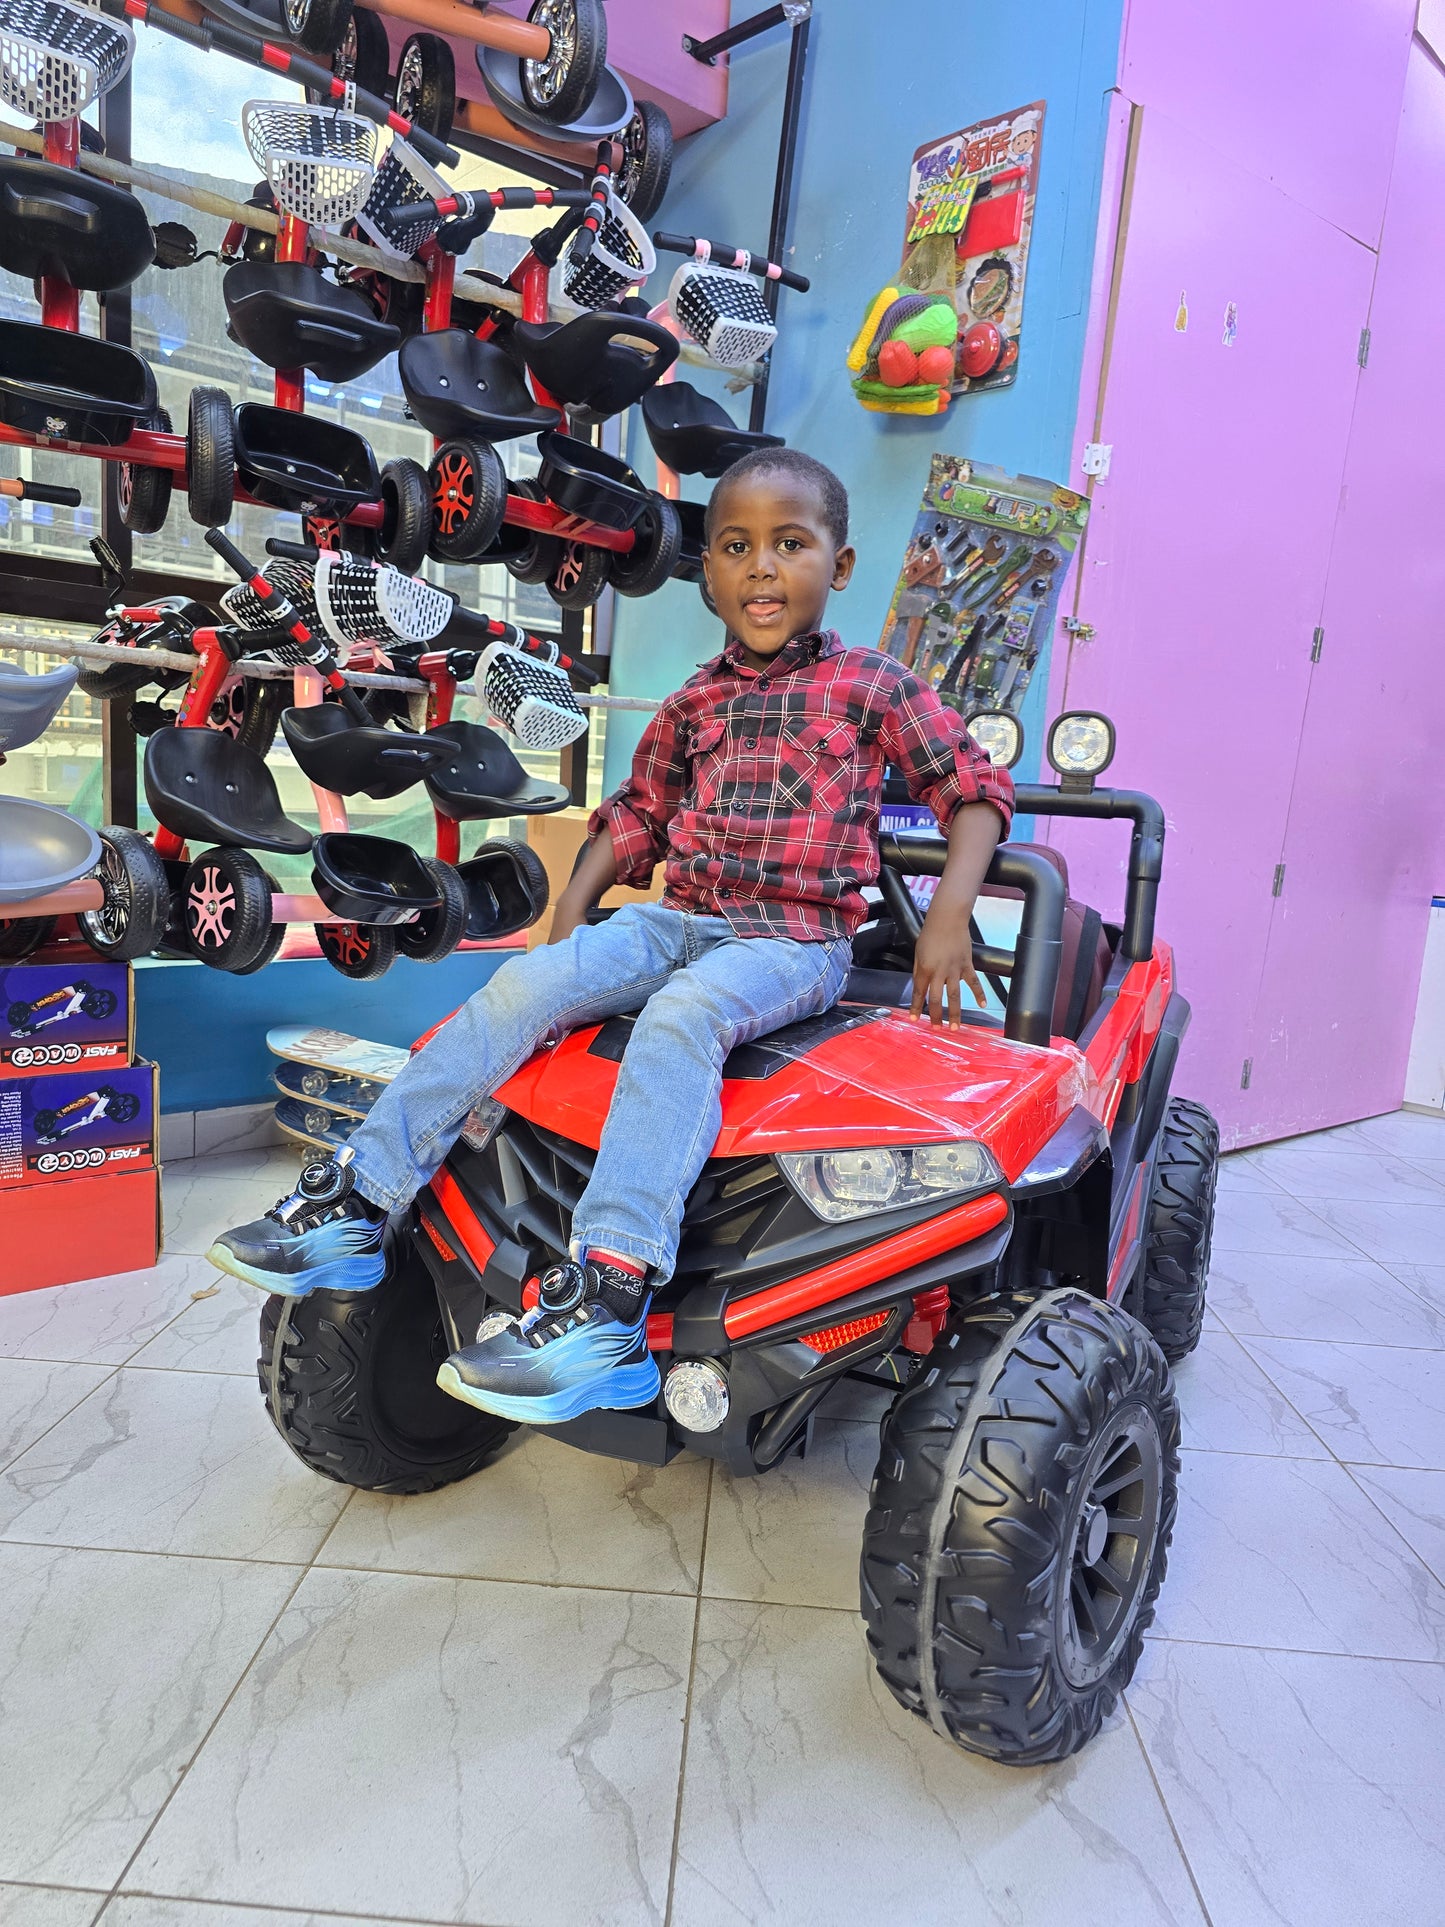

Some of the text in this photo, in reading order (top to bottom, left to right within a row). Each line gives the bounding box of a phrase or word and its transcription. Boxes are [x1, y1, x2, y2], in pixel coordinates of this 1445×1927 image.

[82, 1044, 118, 1058] FAST
[107, 1147, 141, 1161] FAST
[600, 1266, 645, 1296] 23
